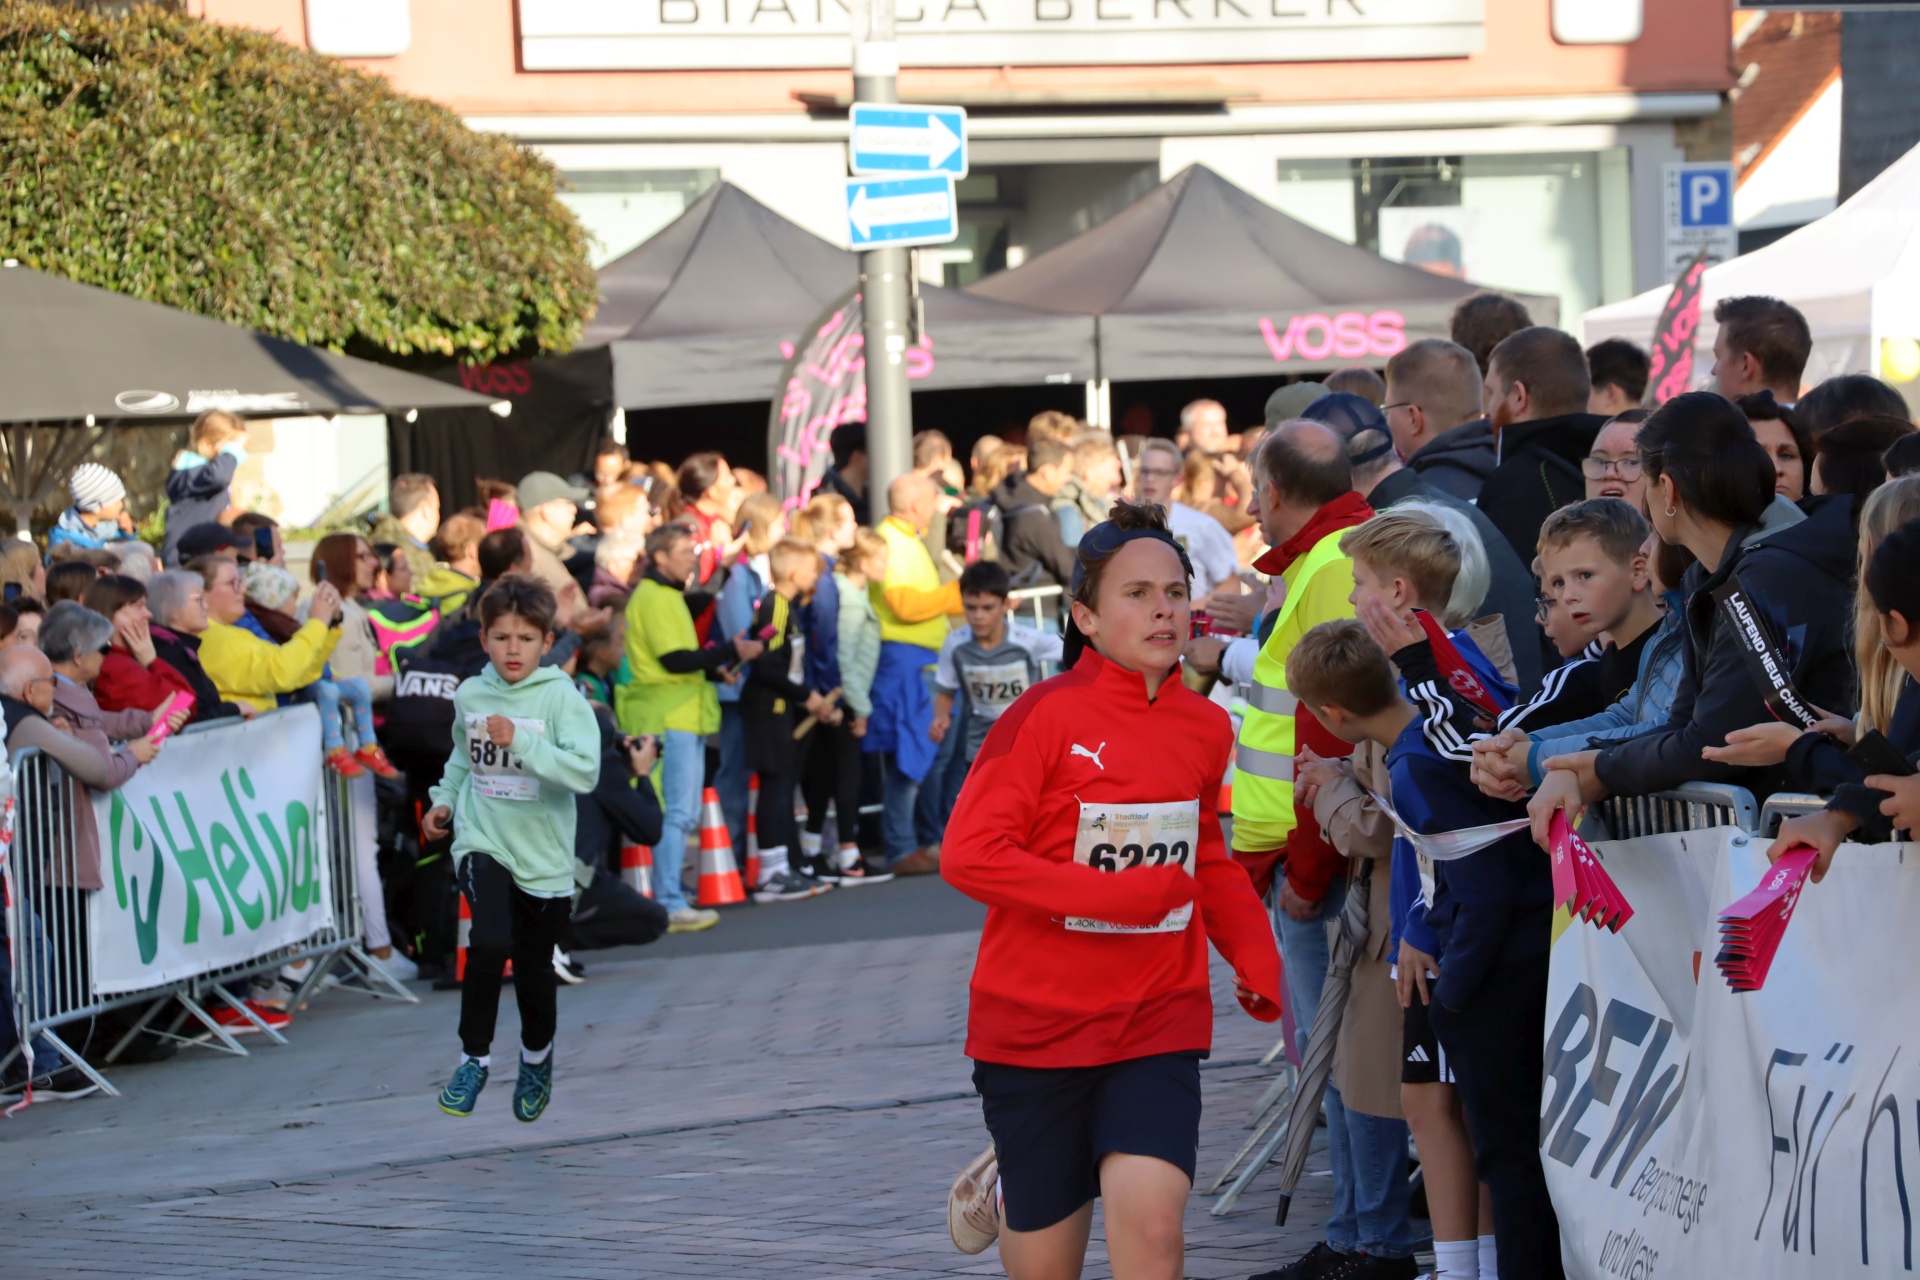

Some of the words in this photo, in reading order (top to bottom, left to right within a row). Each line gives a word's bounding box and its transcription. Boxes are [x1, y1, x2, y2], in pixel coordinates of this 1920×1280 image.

[1690, 175, 1720, 223] P
[1257, 309, 1407, 361] VOSS
[1729, 591, 1767, 653] LAUFEND
[1760, 651, 1785, 690] NEUE
[396, 670, 459, 700] VANS
[470, 738, 523, 770] 581
[1114, 812, 1149, 820] Stadtlauf
[1089, 840, 1190, 874] 6222
[1767, 868, 1792, 891] VOSS
[1074, 918, 1096, 929] AOK
[1539, 981, 1691, 1190] BEW
[1754, 1042, 1857, 1256] Für
